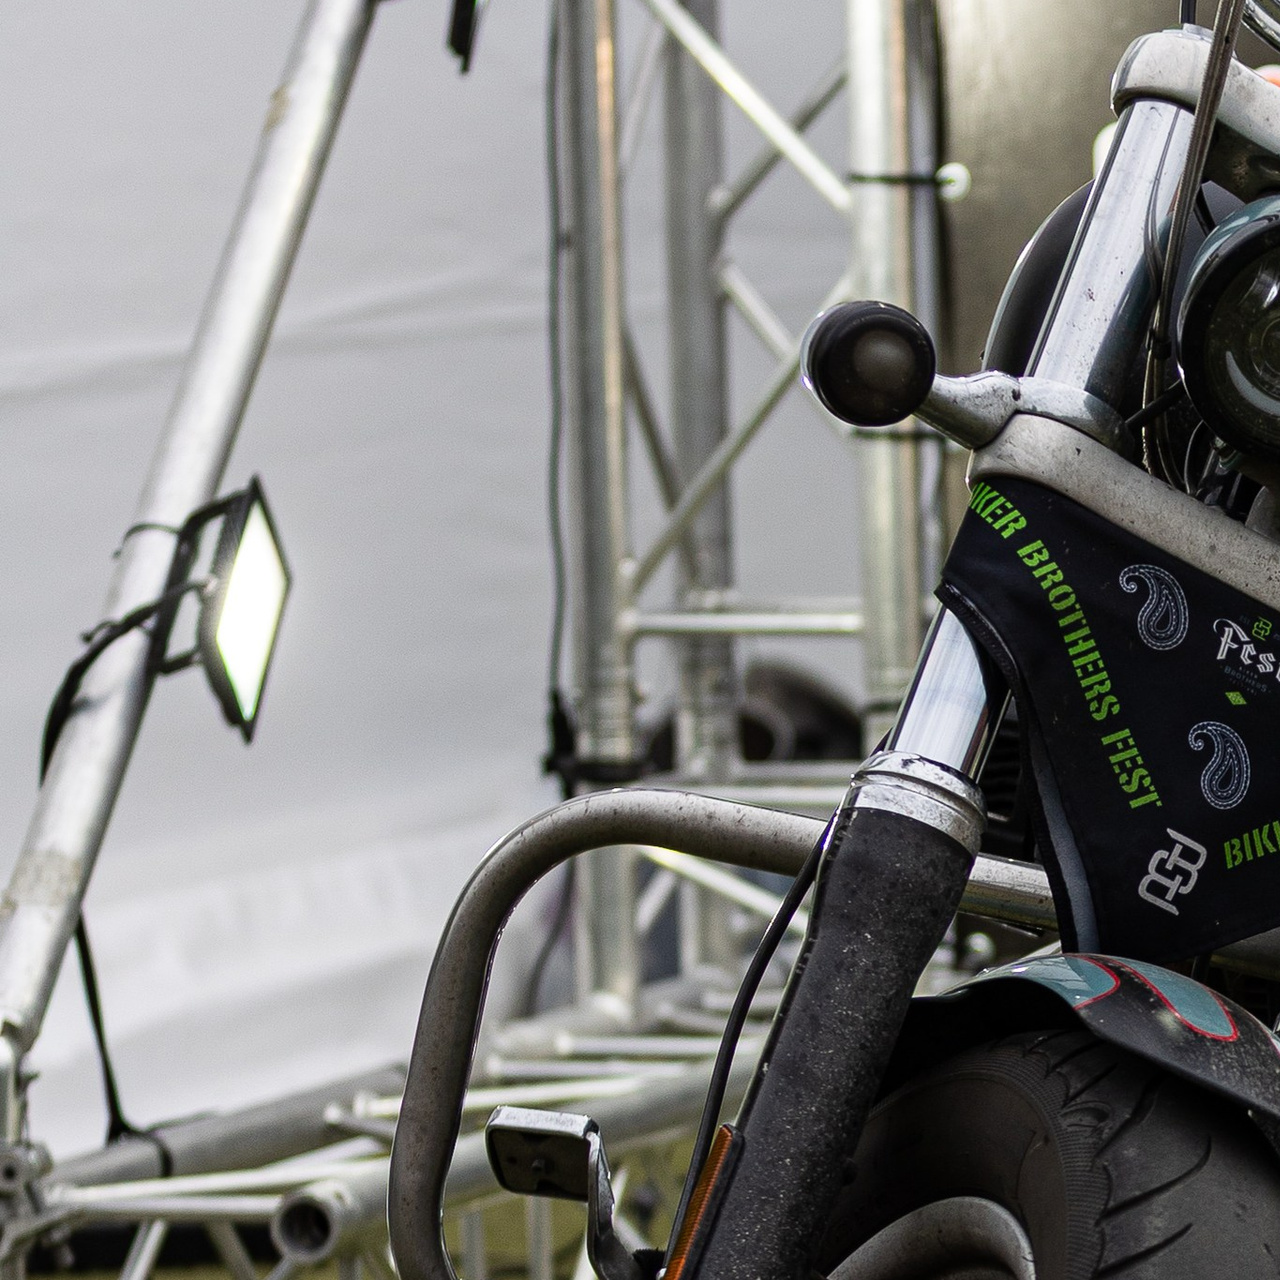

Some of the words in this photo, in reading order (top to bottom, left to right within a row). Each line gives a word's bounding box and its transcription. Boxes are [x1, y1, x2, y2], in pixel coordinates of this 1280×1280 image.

[969, 481, 1027, 539] IKER
[1017, 539, 1120, 721] BROTHERS
[1101, 728, 1163, 809] FEST
